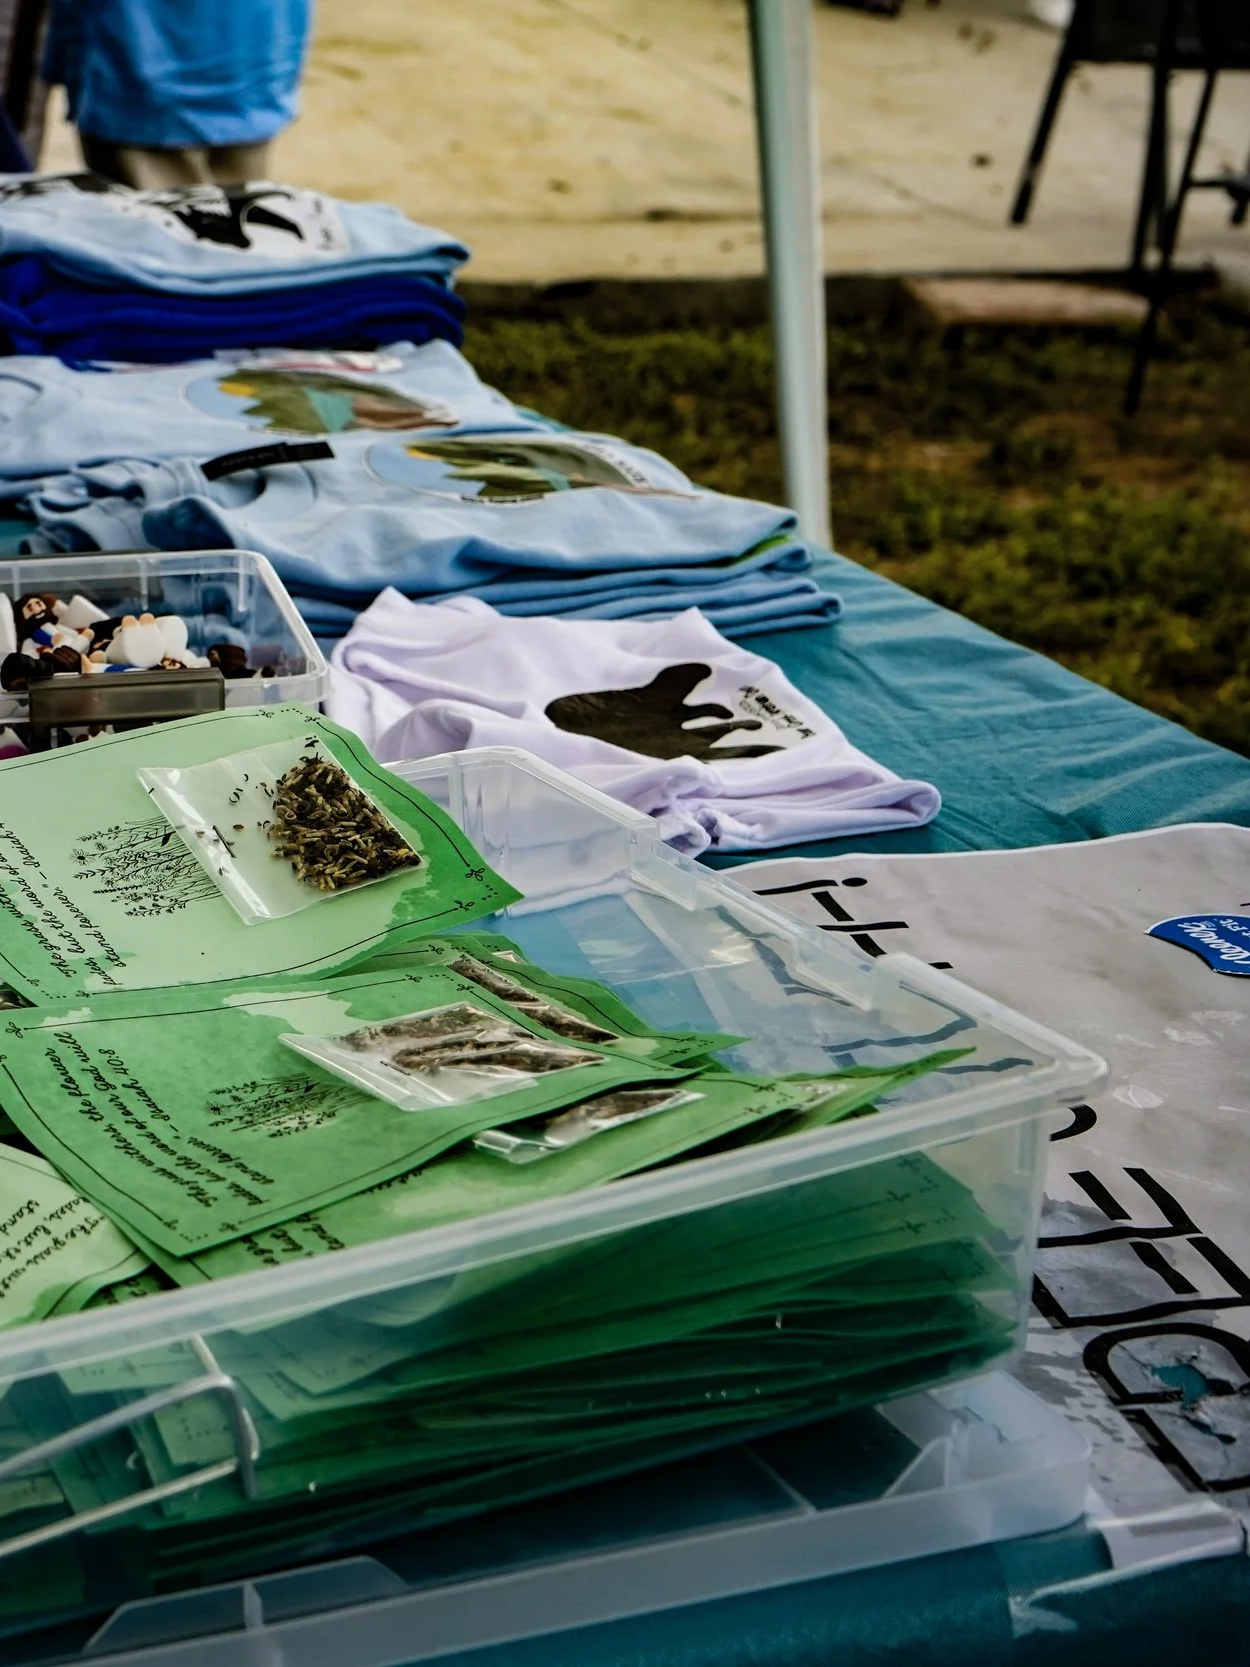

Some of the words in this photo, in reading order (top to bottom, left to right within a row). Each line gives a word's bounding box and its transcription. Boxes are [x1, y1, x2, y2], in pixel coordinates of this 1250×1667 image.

[0, 864, 19, 875] of
[10, 877, 44, 908] word
[42, 910, 64, 930] the
[21, 920, 60, 950] grass
[58, 931, 85, 953] but
[1177, 921, 1250, 965] leenex
[88, 931, 126, 967] stand
[84, 958, 122, 985] fades,
[54, 1032, 90, 1062] will
[45, 1048, 89, 1097] flower
[98, 1049, 128, 1075] 40:8
[82, 1066, 117, 1091] God
[80, 1099, 104, 1122] the
[109, 1094, 132, 1116] our
[128, 1118, 147, 1130] of
[104, 1124, 154, 1166] withers,
[142, 1132, 177, 1155] word
[177, 1156, 201, 1170] the
[196, 1169, 226, 1182] but
[229, 1162, 274, 1184] stand
[24, 1226, 51, 1246] but
[270, 1226, 302, 1252] but
[26, 1238, 66, 1265] grass
